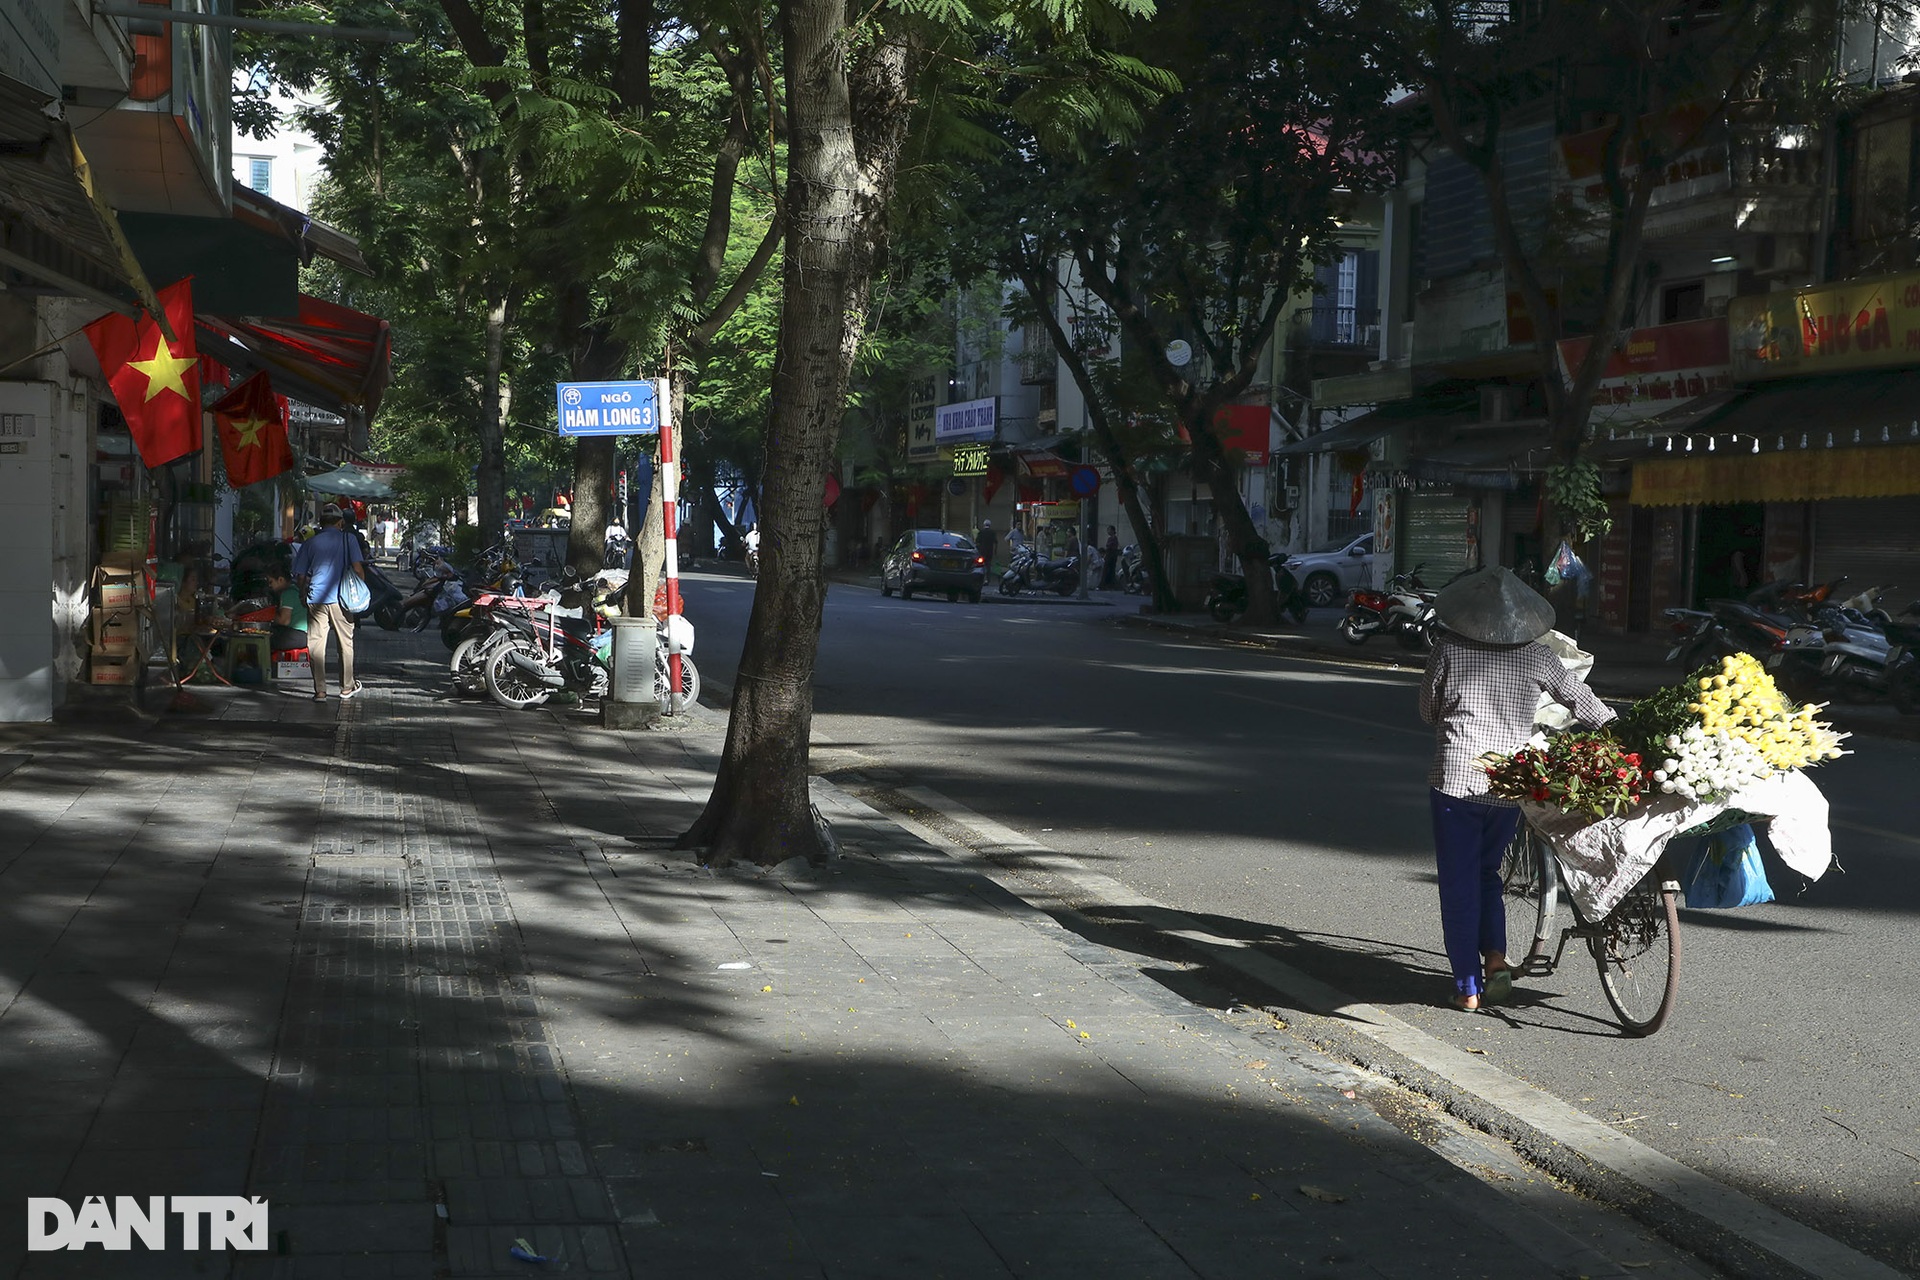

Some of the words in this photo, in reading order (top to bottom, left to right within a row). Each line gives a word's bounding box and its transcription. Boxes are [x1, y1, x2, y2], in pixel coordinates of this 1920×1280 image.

[1802, 296, 1850, 358] PHỞ
[1855, 297, 1891, 352] GÀ
[601, 391, 632, 403] NGÕ
[565, 406, 599, 427] HÀM
[603, 407, 641, 427] LONG
[642, 407, 652, 425] 3
